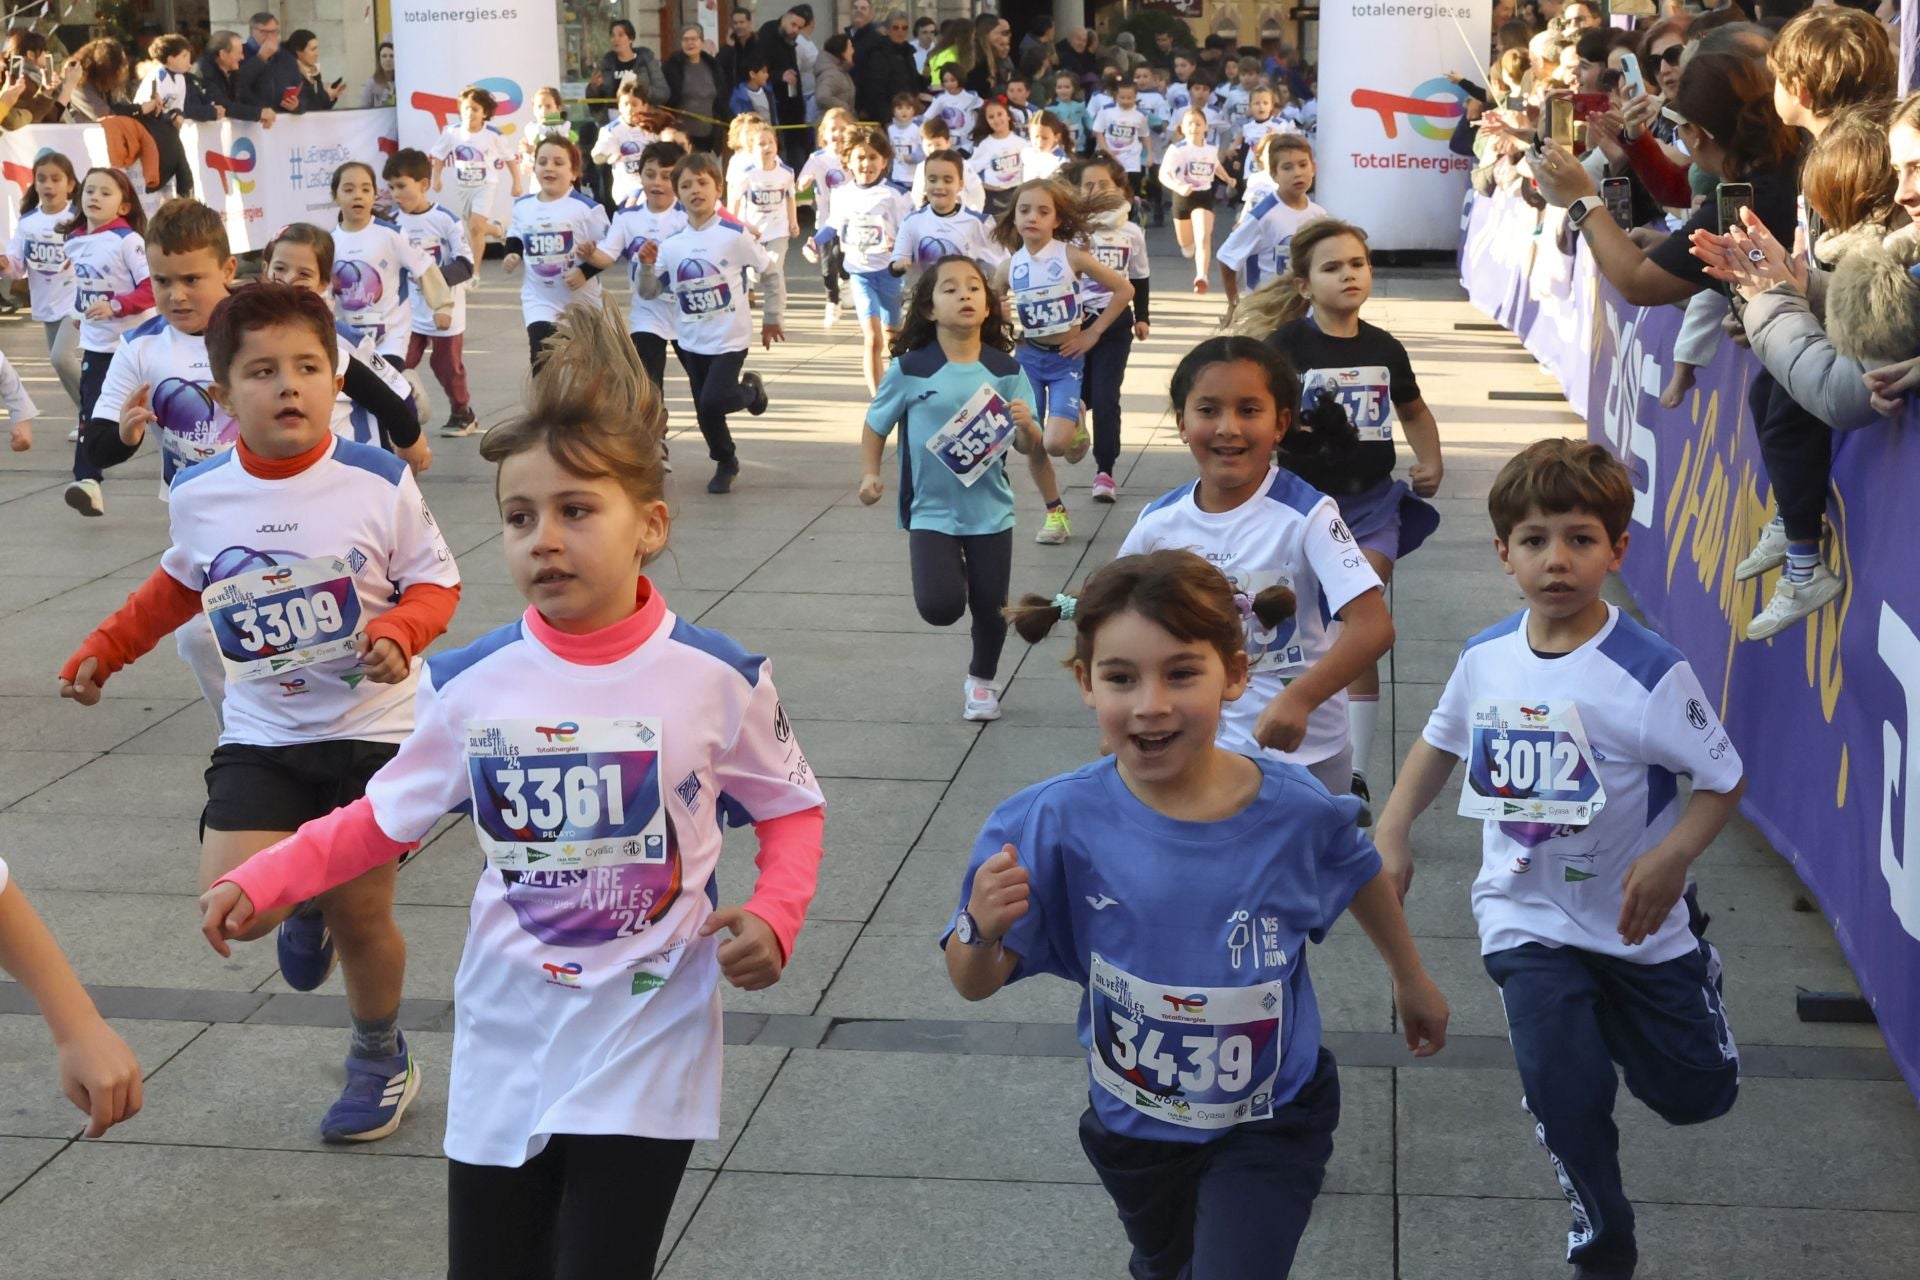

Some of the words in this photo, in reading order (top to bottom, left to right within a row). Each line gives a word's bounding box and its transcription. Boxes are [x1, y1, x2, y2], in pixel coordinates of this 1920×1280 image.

[404, 8, 518, 23] totalenergies.es
[1352, 3, 1472, 19] totalenergies.es
[1351, 153, 1470, 174] TotalEnergies
[30, 241, 64, 261] 3003
[530, 234, 566, 254] 3199
[685, 290, 725, 312] 3391
[1025, 300, 1069, 326] 3431
[948, 409, 1009, 466] 3534
[232, 590, 343, 652] 3309
[536, 746, 580, 754] TotalEnergies
[1490, 739, 1580, 791] 3012
[496, 764, 625, 831] 3361
[542, 830, 576, 839] PELAYO
[579, 883, 654, 911] AVILÉS
[1261, 917, 1279, 933] YES
[1264, 950, 1288, 967] RUN
[1161, 1013, 1207, 1024] TotalEnergies
[1110, 1010, 1253, 1093] 3439
[1154, 1094, 1191, 1110] NORA
[1197, 1110, 1226, 1121] Cyasa
